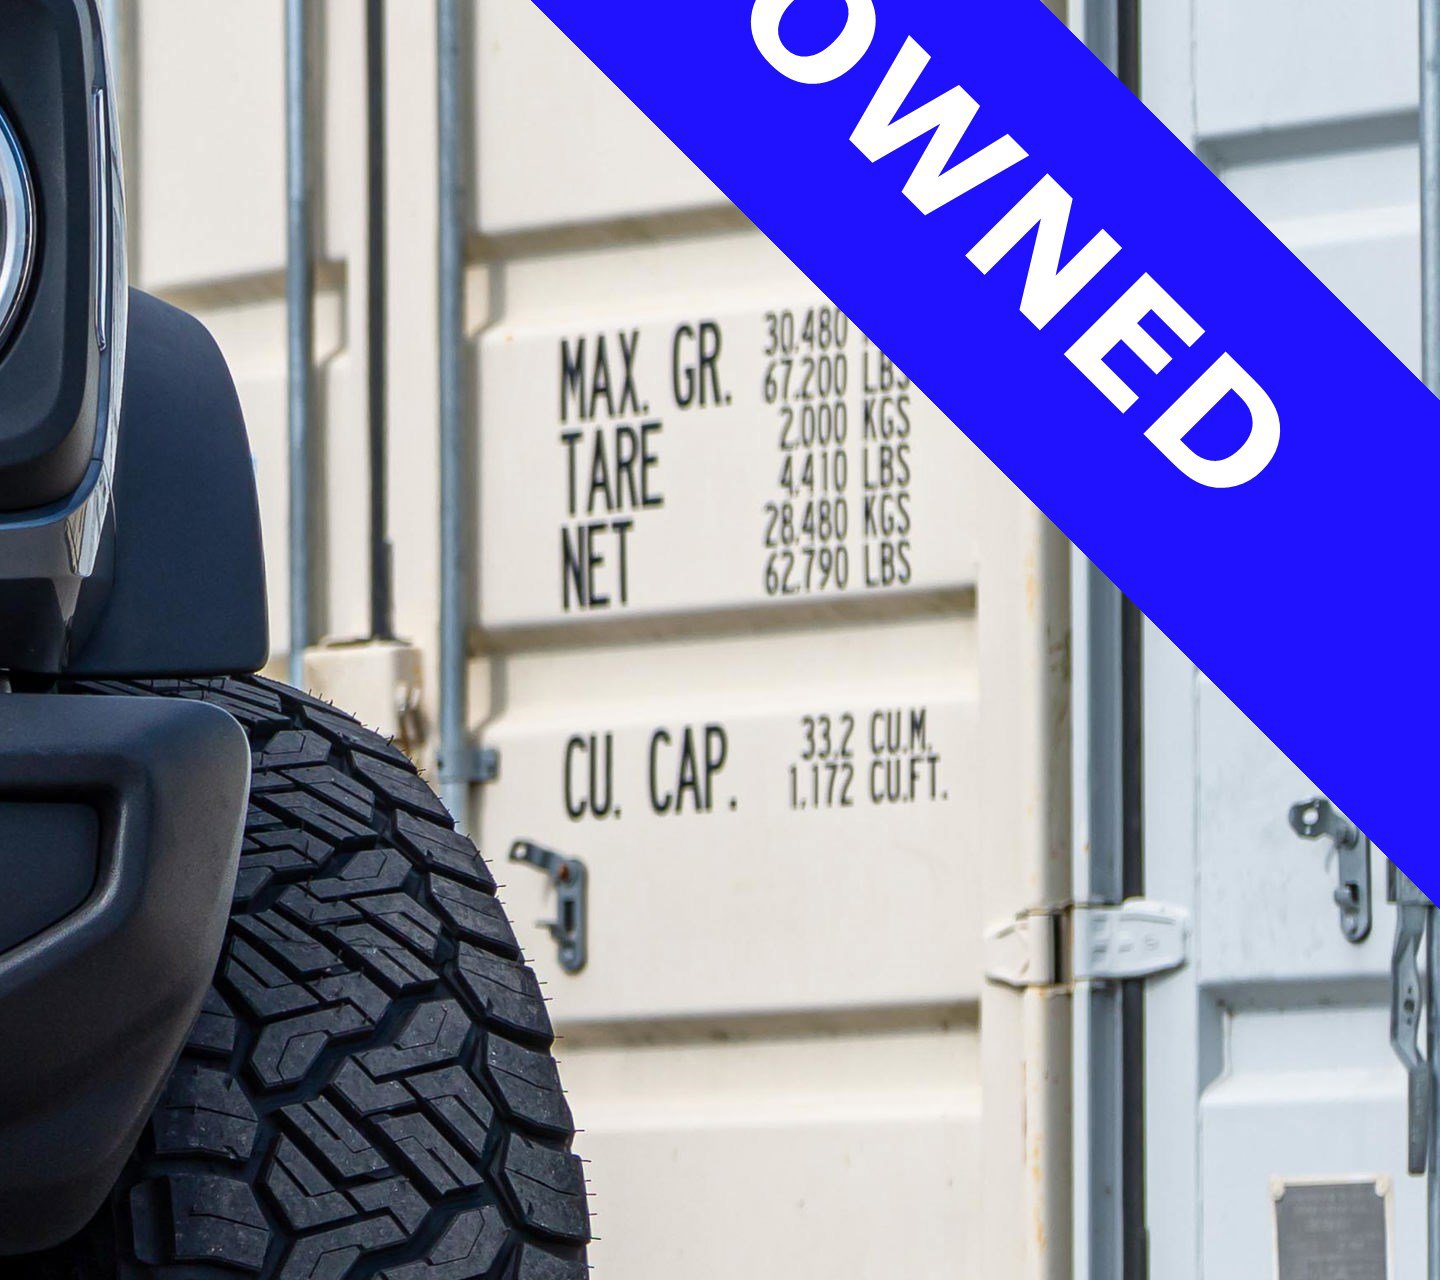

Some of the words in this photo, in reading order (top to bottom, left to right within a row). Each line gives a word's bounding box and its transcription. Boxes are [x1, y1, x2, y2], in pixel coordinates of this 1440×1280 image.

[560, 330, 650, 424] MAX.
[672, 319, 732, 410] GR.
[862, 395, 911, 441] KGS
[561, 420, 665, 516] TARE
[863, 443, 911, 491] LBS
[863, 492, 911, 538] KGS
[561, 520, 635, 612] NET
[864, 540, 912, 588] LBS
[800, 712, 855, 762] 33.2
[565, 731, 622, 821] CU.
[649, 721, 738, 816] CAP.
